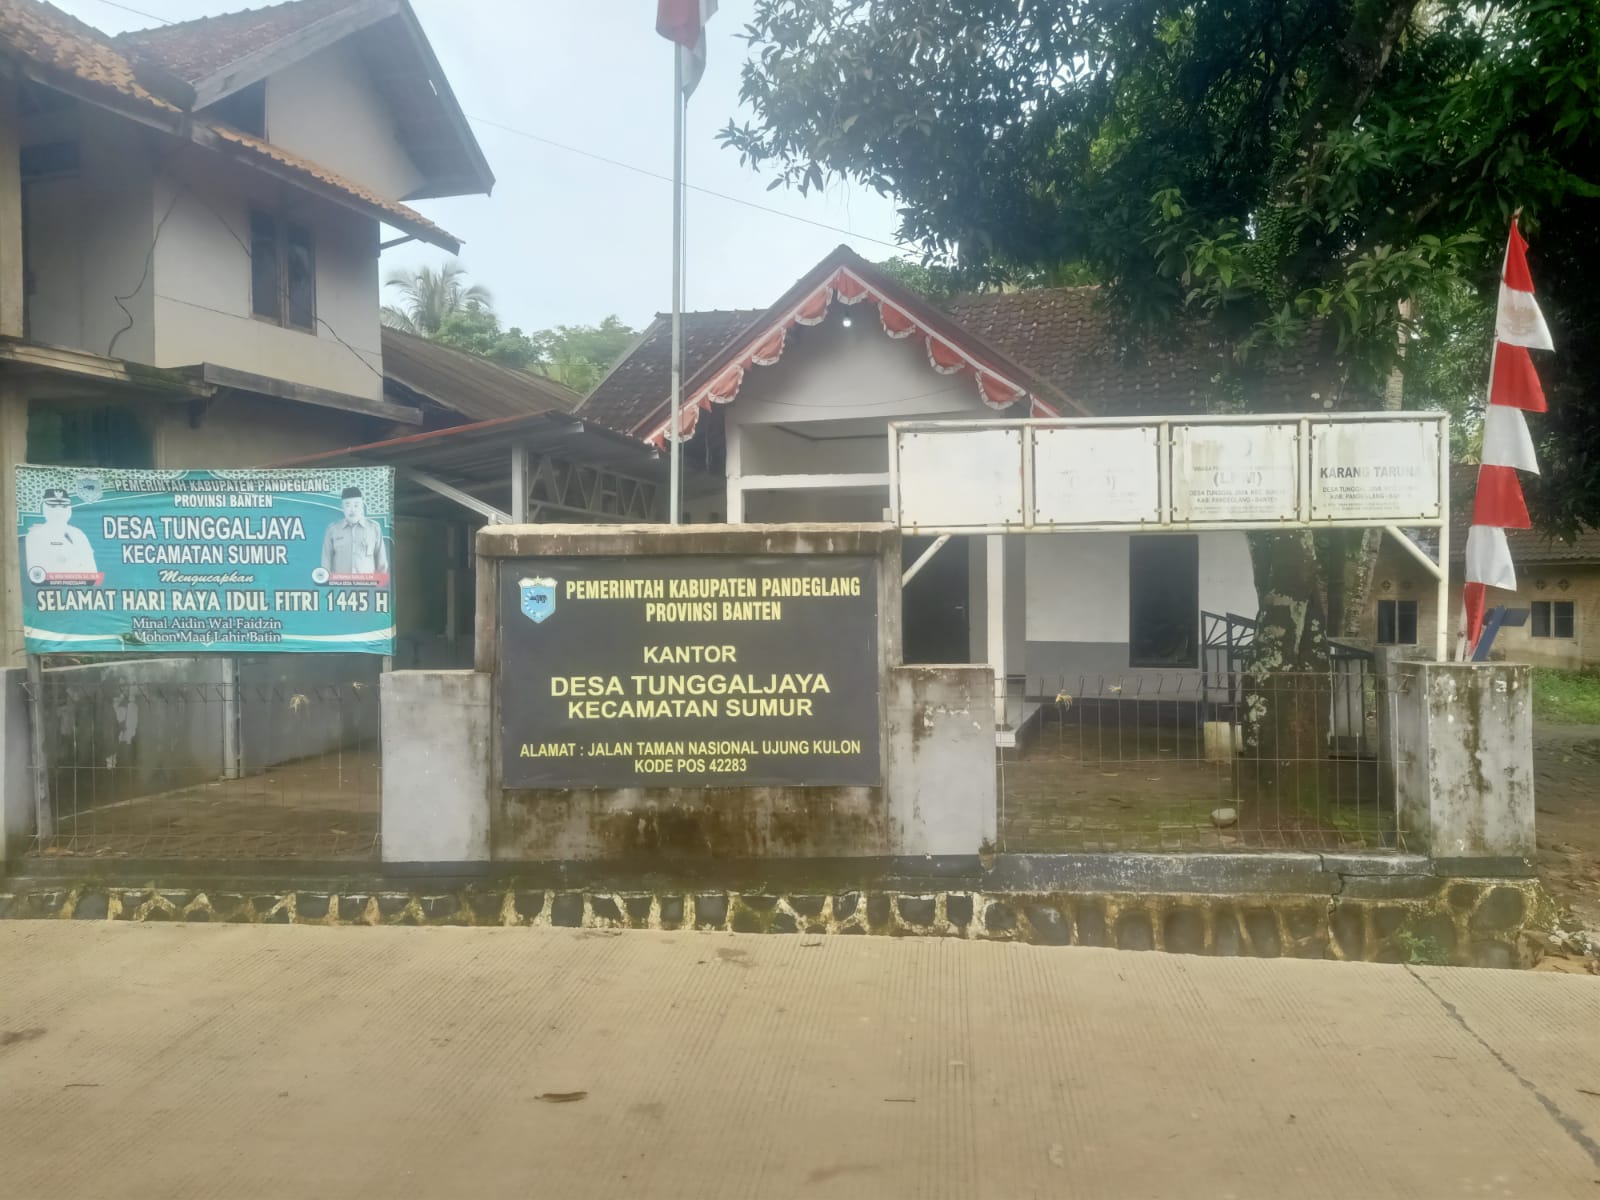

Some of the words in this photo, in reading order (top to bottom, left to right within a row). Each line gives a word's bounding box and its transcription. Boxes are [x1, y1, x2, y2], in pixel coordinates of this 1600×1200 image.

[1320, 466, 1370, 478] KARANG
[115, 479, 185, 493] PEMERINTAH
[190, 479, 254, 492] KABUPATEN
[257, 478, 331, 492] PANDEGLANG
[174, 494, 227, 507] PROVINSI
[229, 494, 273, 508] BANTEN
[103, 516, 157, 539] DESA
[160, 517, 305, 541] TUNGGALJAYA
[122, 544, 223, 564] KECAMATAN
[228, 545, 288, 564] SUMUR
[158, 569, 254, 586] Mengucapkan
[566, 579, 664, 600] PEMERINTAH
[669, 578, 757, 599] KABUPATEN
[762, 577, 861, 597] PANDEGLANG
[37, 590, 116, 611] SELAMAT
[122, 591, 166, 611] HARI
[171, 591, 221, 611] RAYA
[226, 591, 268, 611] IDUL
[275, 591, 319, 611] FITRI
[327, 592, 369, 612] 1445
[375, 592, 389, 613] H
[646, 602, 718, 622] PROVINSI
[722, 601, 782, 621] BANTEN
[132, 617, 168, 629] Minal
[170, 617, 205, 629] Aidin
[208, 617, 232, 629] Wal
[236, 617, 282, 629] Faidzin
[134, 631, 178, 643] Mohon
[182, 631, 211, 643] Maaf
[214, 632, 247, 643] Lahir
[249, 632, 281, 643] Batin
[643, 645, 737, 664] KANTOR
[551, 676, 625, 697] DESA
[631, 673, 831, 695] TUNGGALJAYA
[568, 700, 718, 719] KECAMATAN
[725, 698, 814, 717] SUMUR
[520, 743, 577, 757] ALAMAT
[579, 745, 584, 756] :
[587, 742, 633, 756] JALAN
[637, 742, 684, 756] TAMAN
[688, 741, 759, 755] NASIONAL
[762, 741, 809, 755] UJUNG
[813, 740, 861, 754] KULON
[634, 759, 674, 773] KODE
[677, 758, 706, 773] POS
[708, 758, 748, 772] 42283
